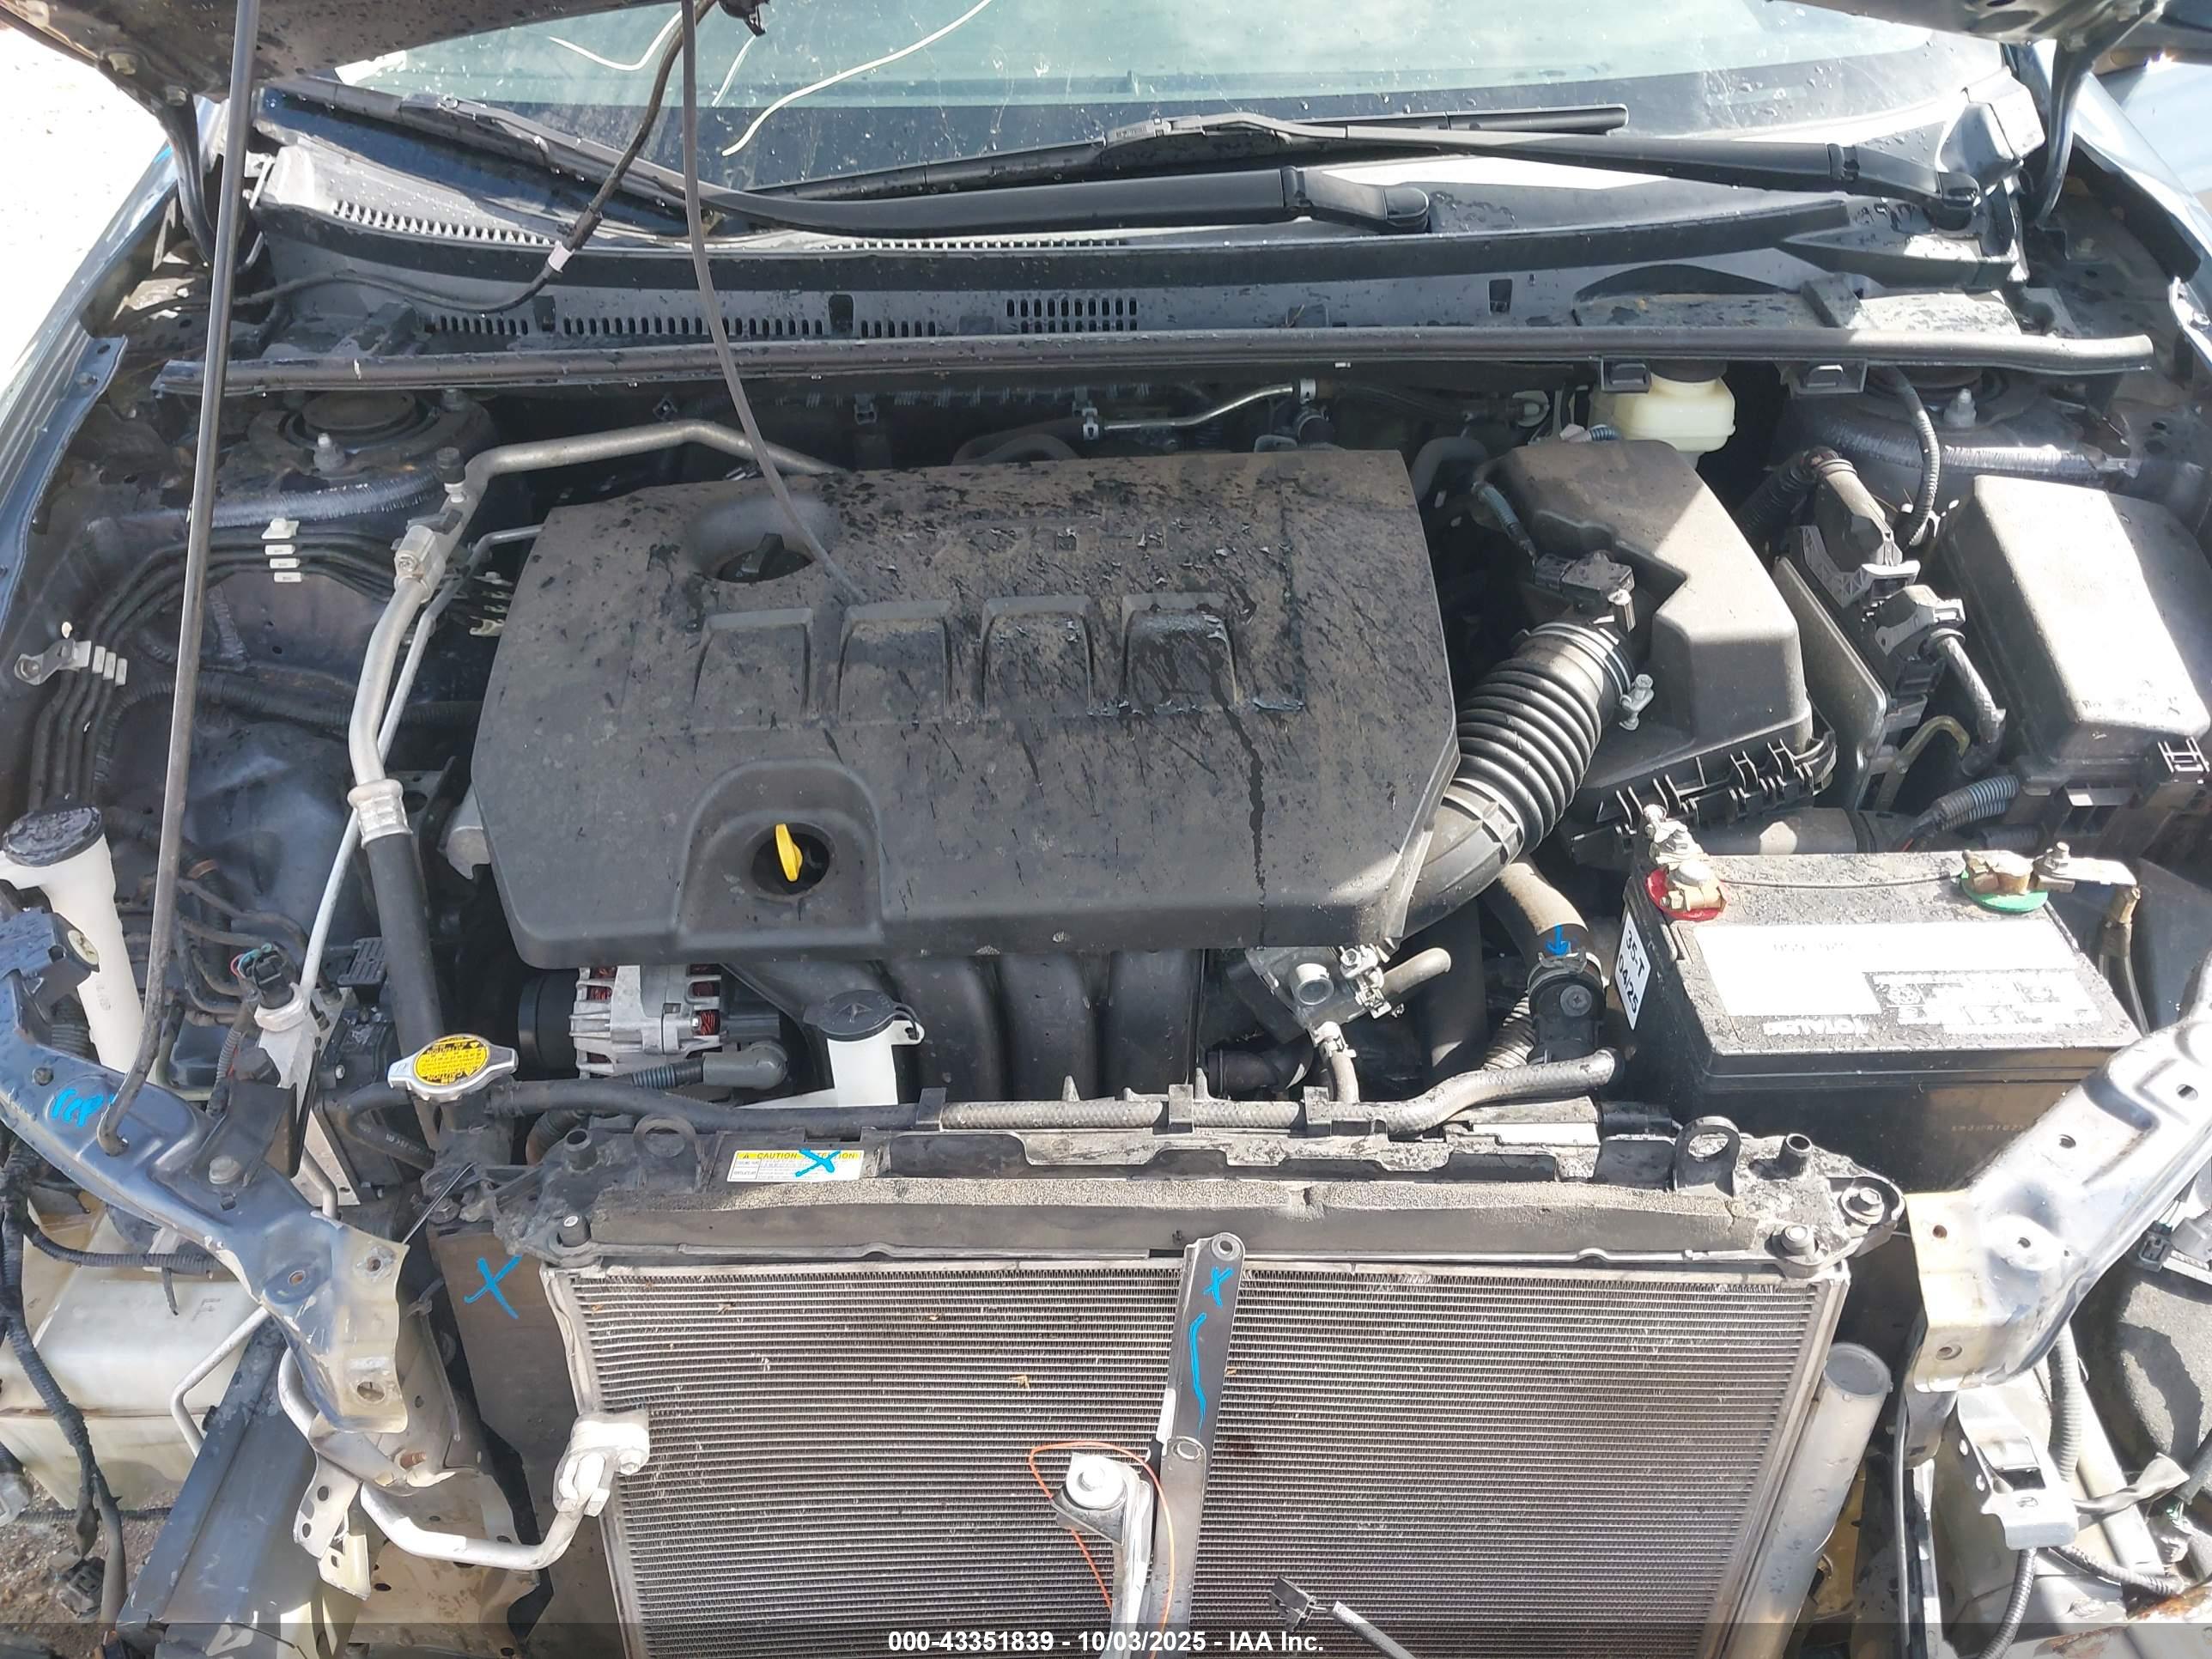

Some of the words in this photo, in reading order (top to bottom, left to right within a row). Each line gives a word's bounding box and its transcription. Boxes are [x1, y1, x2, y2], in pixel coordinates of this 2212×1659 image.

[1626, 929, 1645, 978] 35-T
[1618, 953, 1639, 1014] 04/25
[757, 1152, 799, 1160] CAUTION
